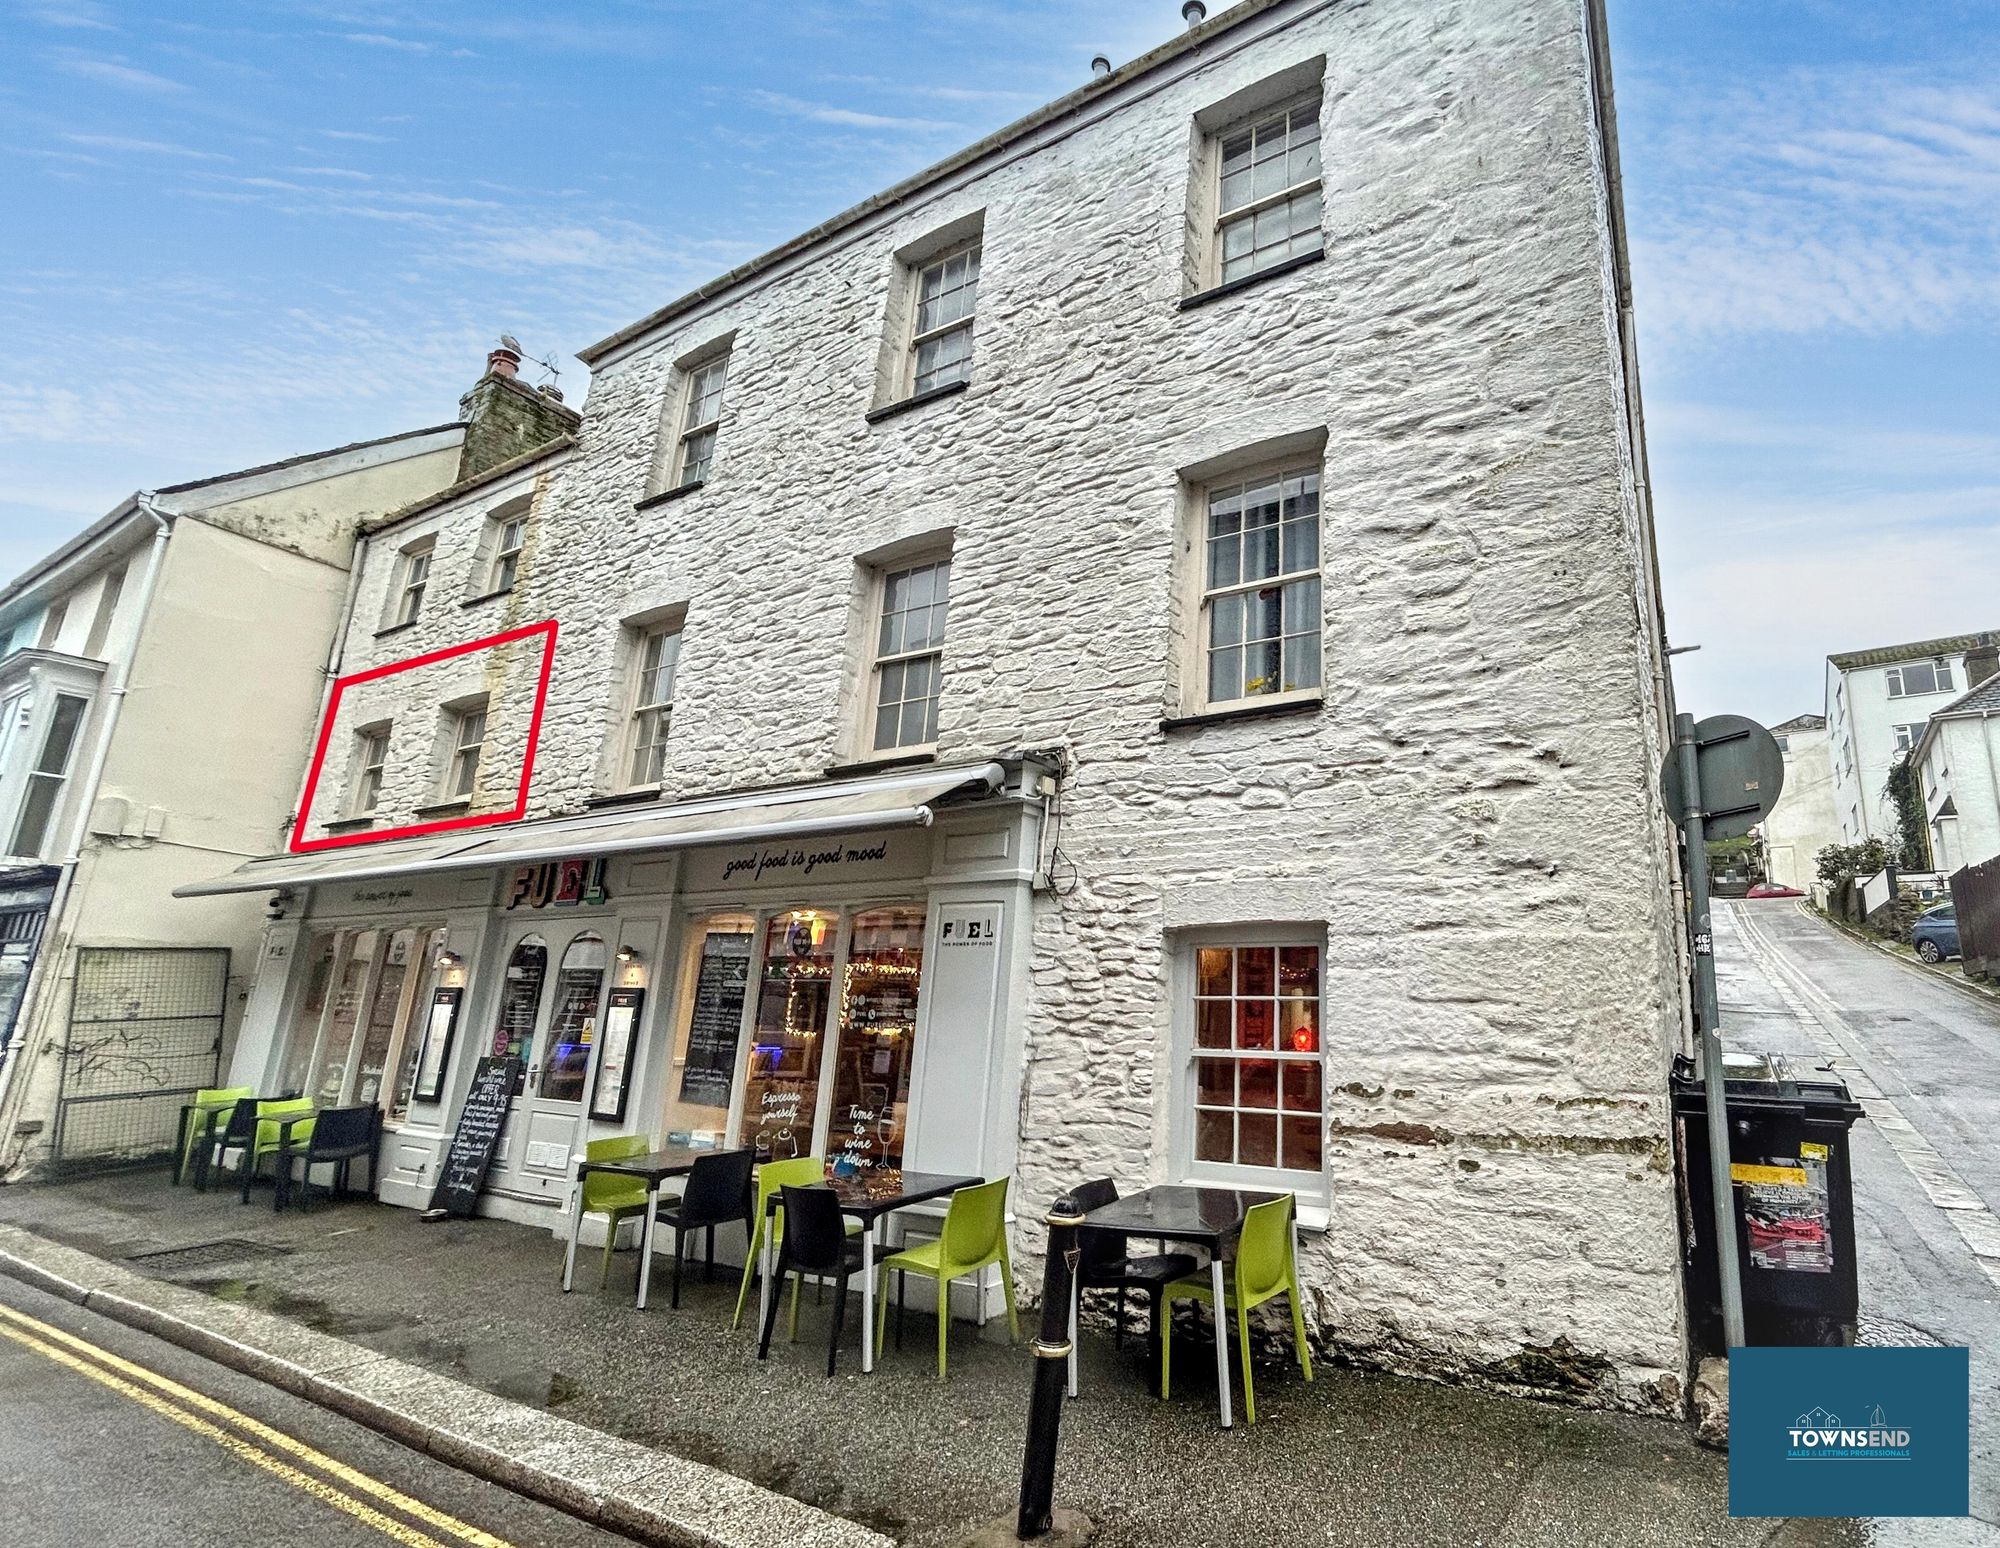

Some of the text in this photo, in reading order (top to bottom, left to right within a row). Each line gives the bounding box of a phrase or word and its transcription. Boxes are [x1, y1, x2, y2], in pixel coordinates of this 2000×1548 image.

[723, 840, 887, 881] good food is good mood
[506, 857, 606, 910] FUEL
[942, 918, 994, 938] FUEL
[761, 1092, 801, 1107] Espresso
[760, 1104, 799, 1126] yourself
[849, 1104, 875, 1120] Time
[853, 1121, 866, 1135] to
[844, 1136, 873, 1149] wine
[844, 1150, 873, 1167] down
